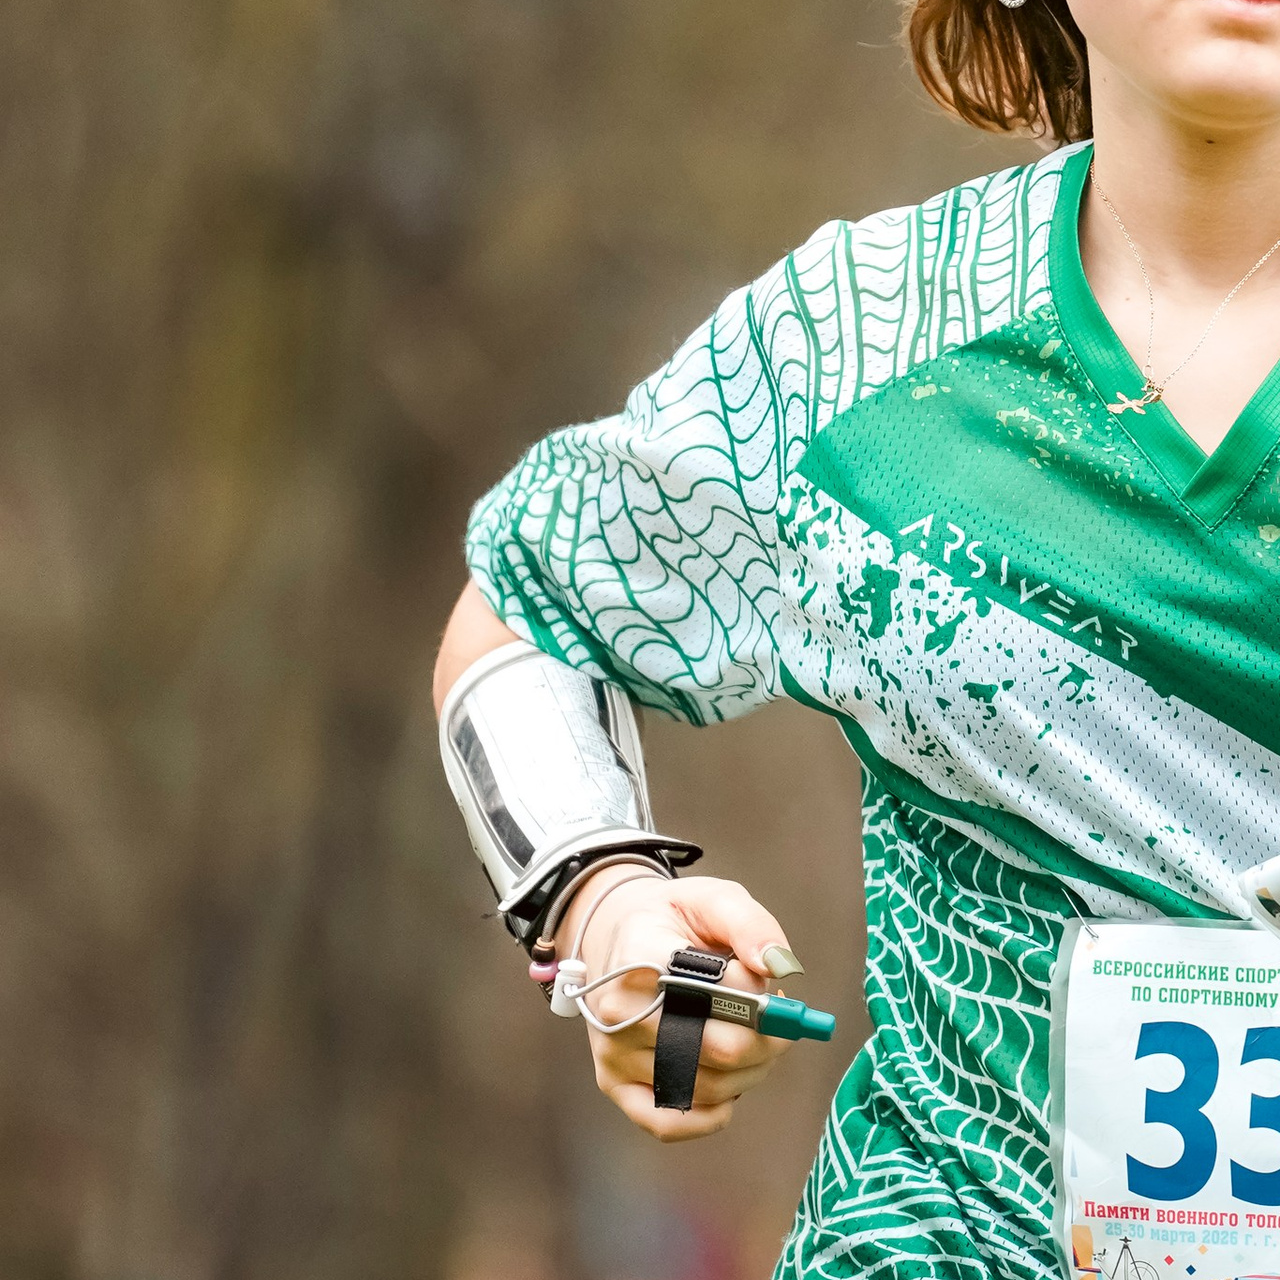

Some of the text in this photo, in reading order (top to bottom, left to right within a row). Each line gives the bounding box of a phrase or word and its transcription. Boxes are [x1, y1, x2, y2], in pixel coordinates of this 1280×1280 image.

[1093, 959, 1229, 982] ВСЕРОССИЙСКИЕ
[713, 998, 746, 1013] 1410120
[1131, 986, 1152, 1002] ПО
[1158, 987, 1279, 1008] СПОРТИВНОМУ
[1084, 1201, 1150, 1221] Памяти
[1156, 1209, 1239, 1227] военного
[1105, 1222, 1145, 1239] 25-30
[1150, 1227, 1196, 1246] марта
[1202, 1229, 1239, 1245] 2026
